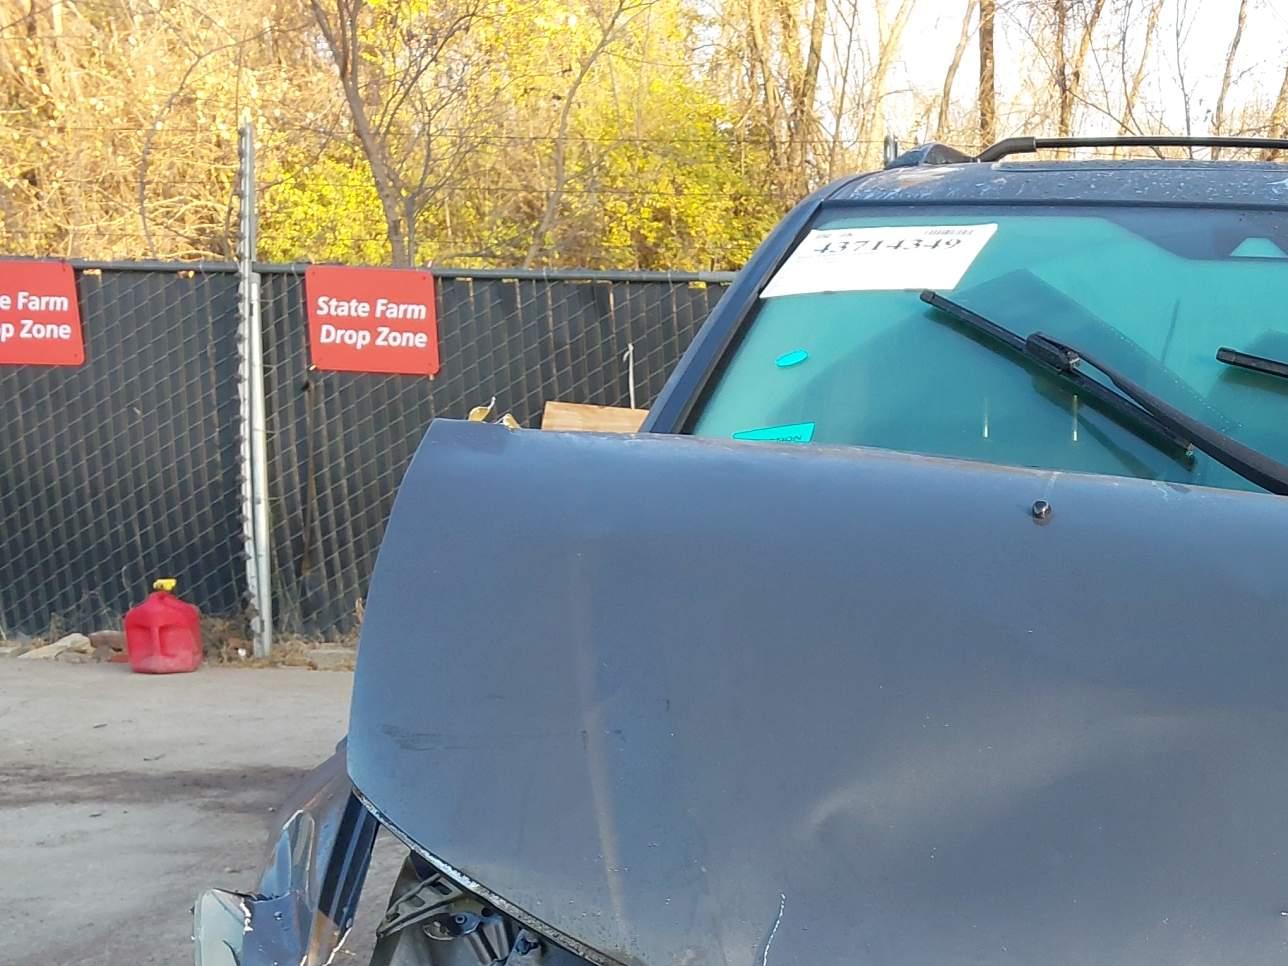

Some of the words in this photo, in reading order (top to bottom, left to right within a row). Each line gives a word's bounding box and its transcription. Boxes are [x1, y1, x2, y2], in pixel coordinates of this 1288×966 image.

[813, 238, 962, 254] 43714349
[17, 291, 69, 312] Farm
[316, 296, 371, 317] State
[375, 298, 427, 320] Farm
[19, 319, 72, 340] Zone
[320, 324, 372, 350] Drop
[375, 326, 428, 348] Zone
